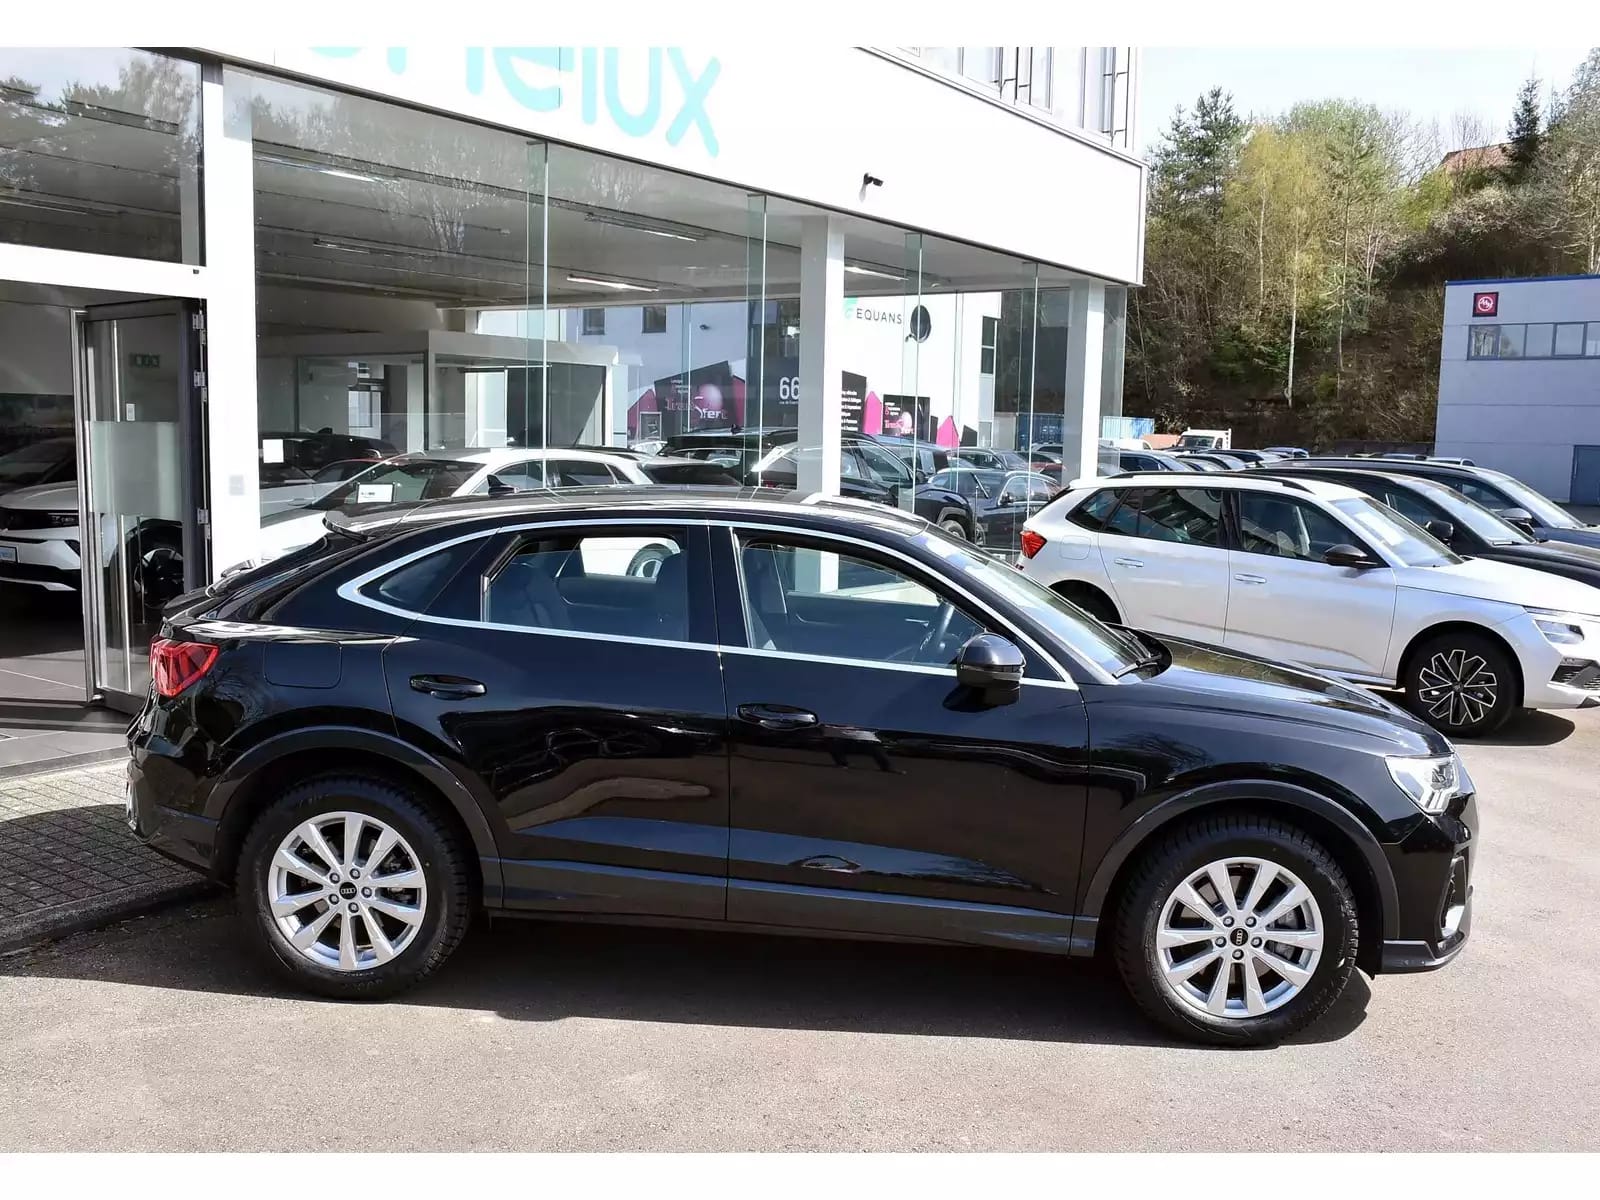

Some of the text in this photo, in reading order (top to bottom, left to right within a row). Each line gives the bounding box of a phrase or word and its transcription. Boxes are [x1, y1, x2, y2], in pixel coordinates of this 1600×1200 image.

[307, 46, 722, 159] elux
[856, 307, 903, 325] EQUANS
[779, 376, 800, 400] 66
